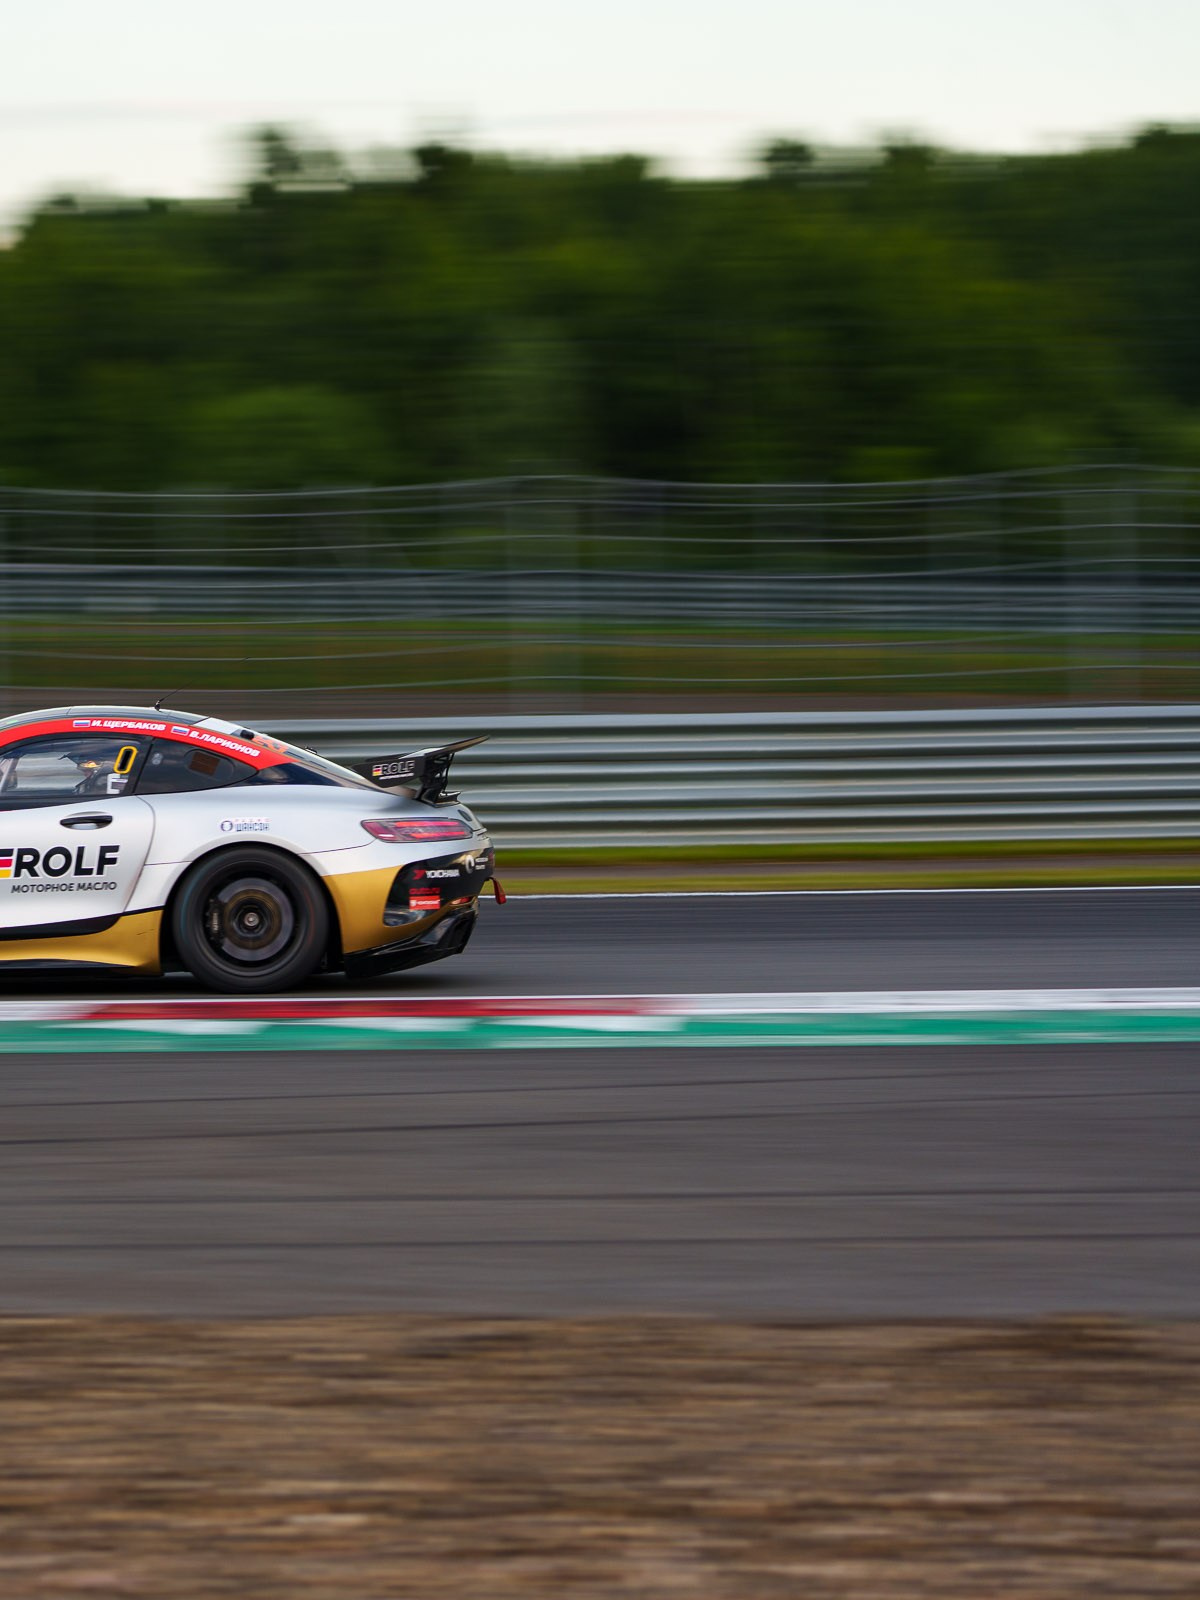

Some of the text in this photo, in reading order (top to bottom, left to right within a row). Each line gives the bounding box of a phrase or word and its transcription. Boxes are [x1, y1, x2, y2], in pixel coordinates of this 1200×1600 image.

[381, 760, 415, 775] ROLF
[14, 845, 120, 877] ROLF
[11, 881, 118, 894] МОТОРНОЕ МАСЛО
